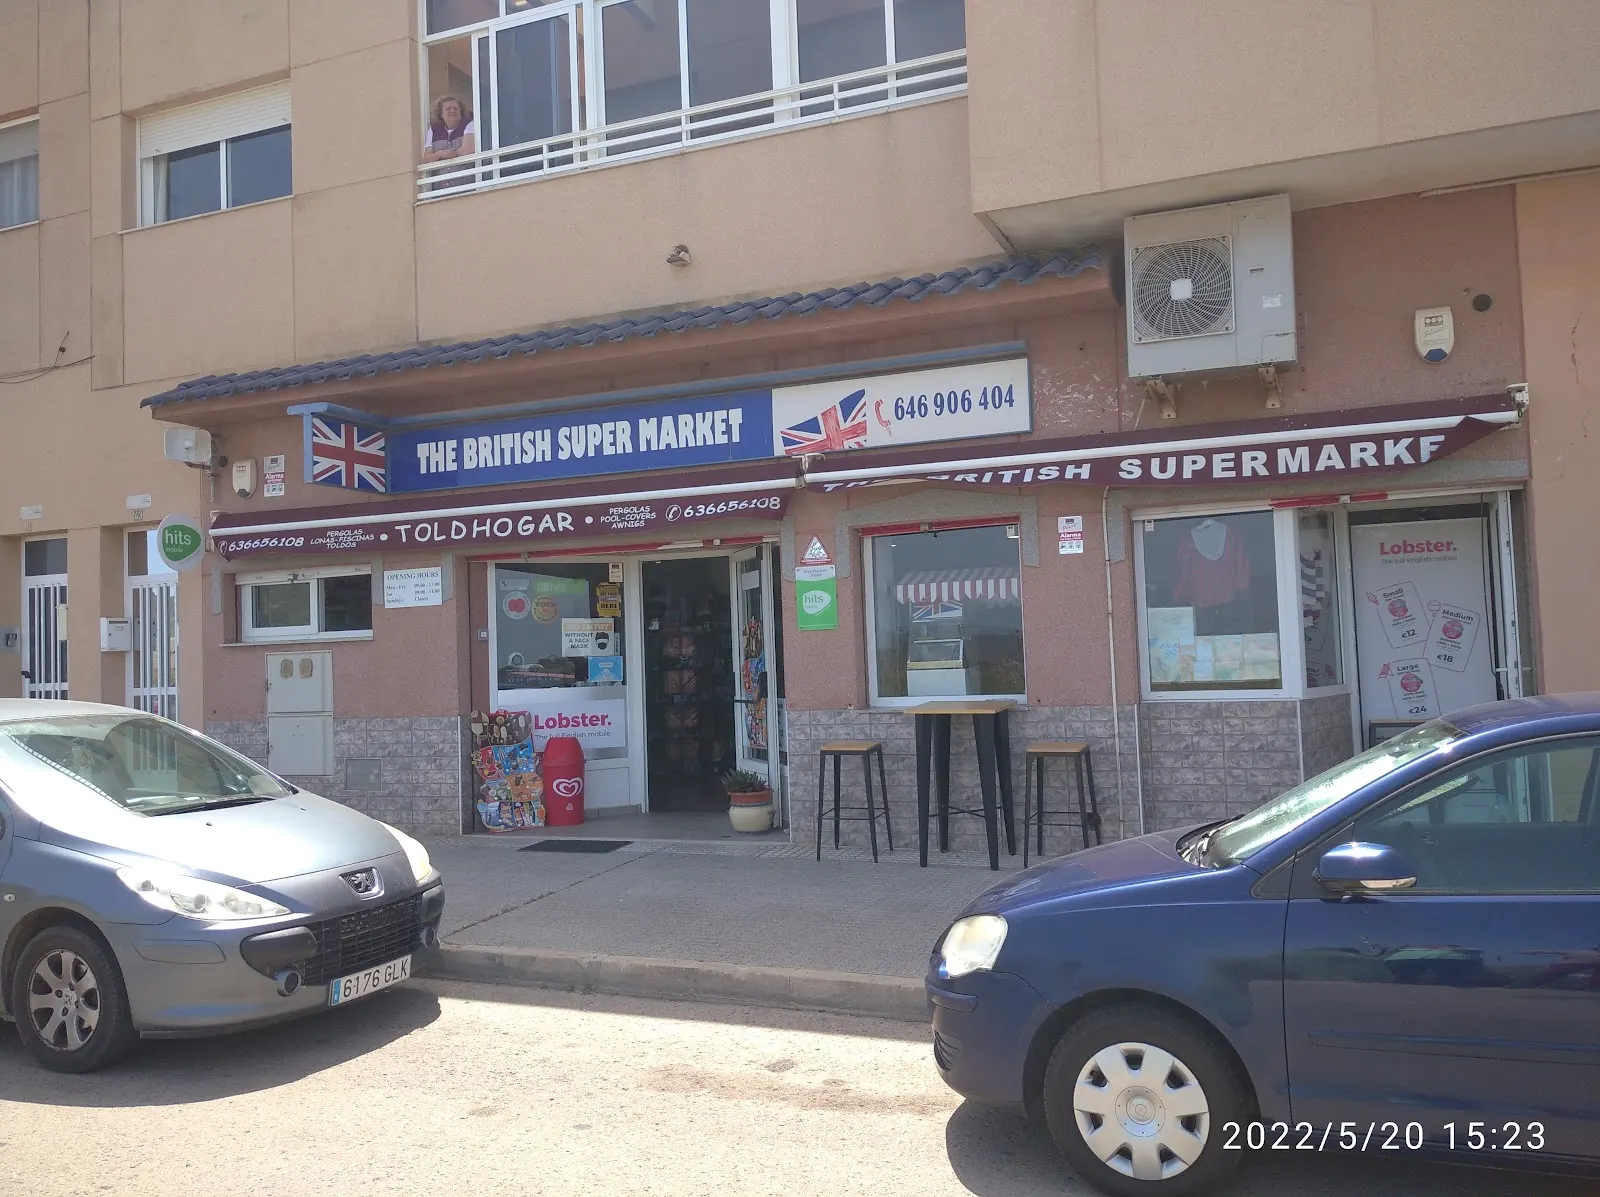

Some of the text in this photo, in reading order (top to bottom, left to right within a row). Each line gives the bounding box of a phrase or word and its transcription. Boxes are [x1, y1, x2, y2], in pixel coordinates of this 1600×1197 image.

[894, 384, 1015, 420] 646 906 404
[416, 408, 743, 474] THE BRITISH SUPER MARKET
[609, 505, 650, 515] PERGOLAS
[684, 496, 780, 518] 636656108
[600, 512, 656, 523] POOL-COVERS
[394, 512, 575, 542] TOLDHOGAR
[611, 520, 646, 529] AWNIGS
[165, 529, 192, 545] hits
[326, 529, 363, 537] PERGOLAS
[228, 537, 304, 552] 636656108
[310, 534, 374, 545] LONAS-PISCINAS
[1380, 540, 1457, 556] Lobster.
[805, 594, 824, 603] hits
[1382, 588, 1404, 598] Small
[1442, 609, 1473, 621] Medium
[1402, 629, 1416, 638] €12
[1437, 654, 1453, 663] €18
[1409, 706, 1427, 714] €24
[534, 712, 612, 729] Lobster.
[343, 958, 408, 998] 6176 GLK
